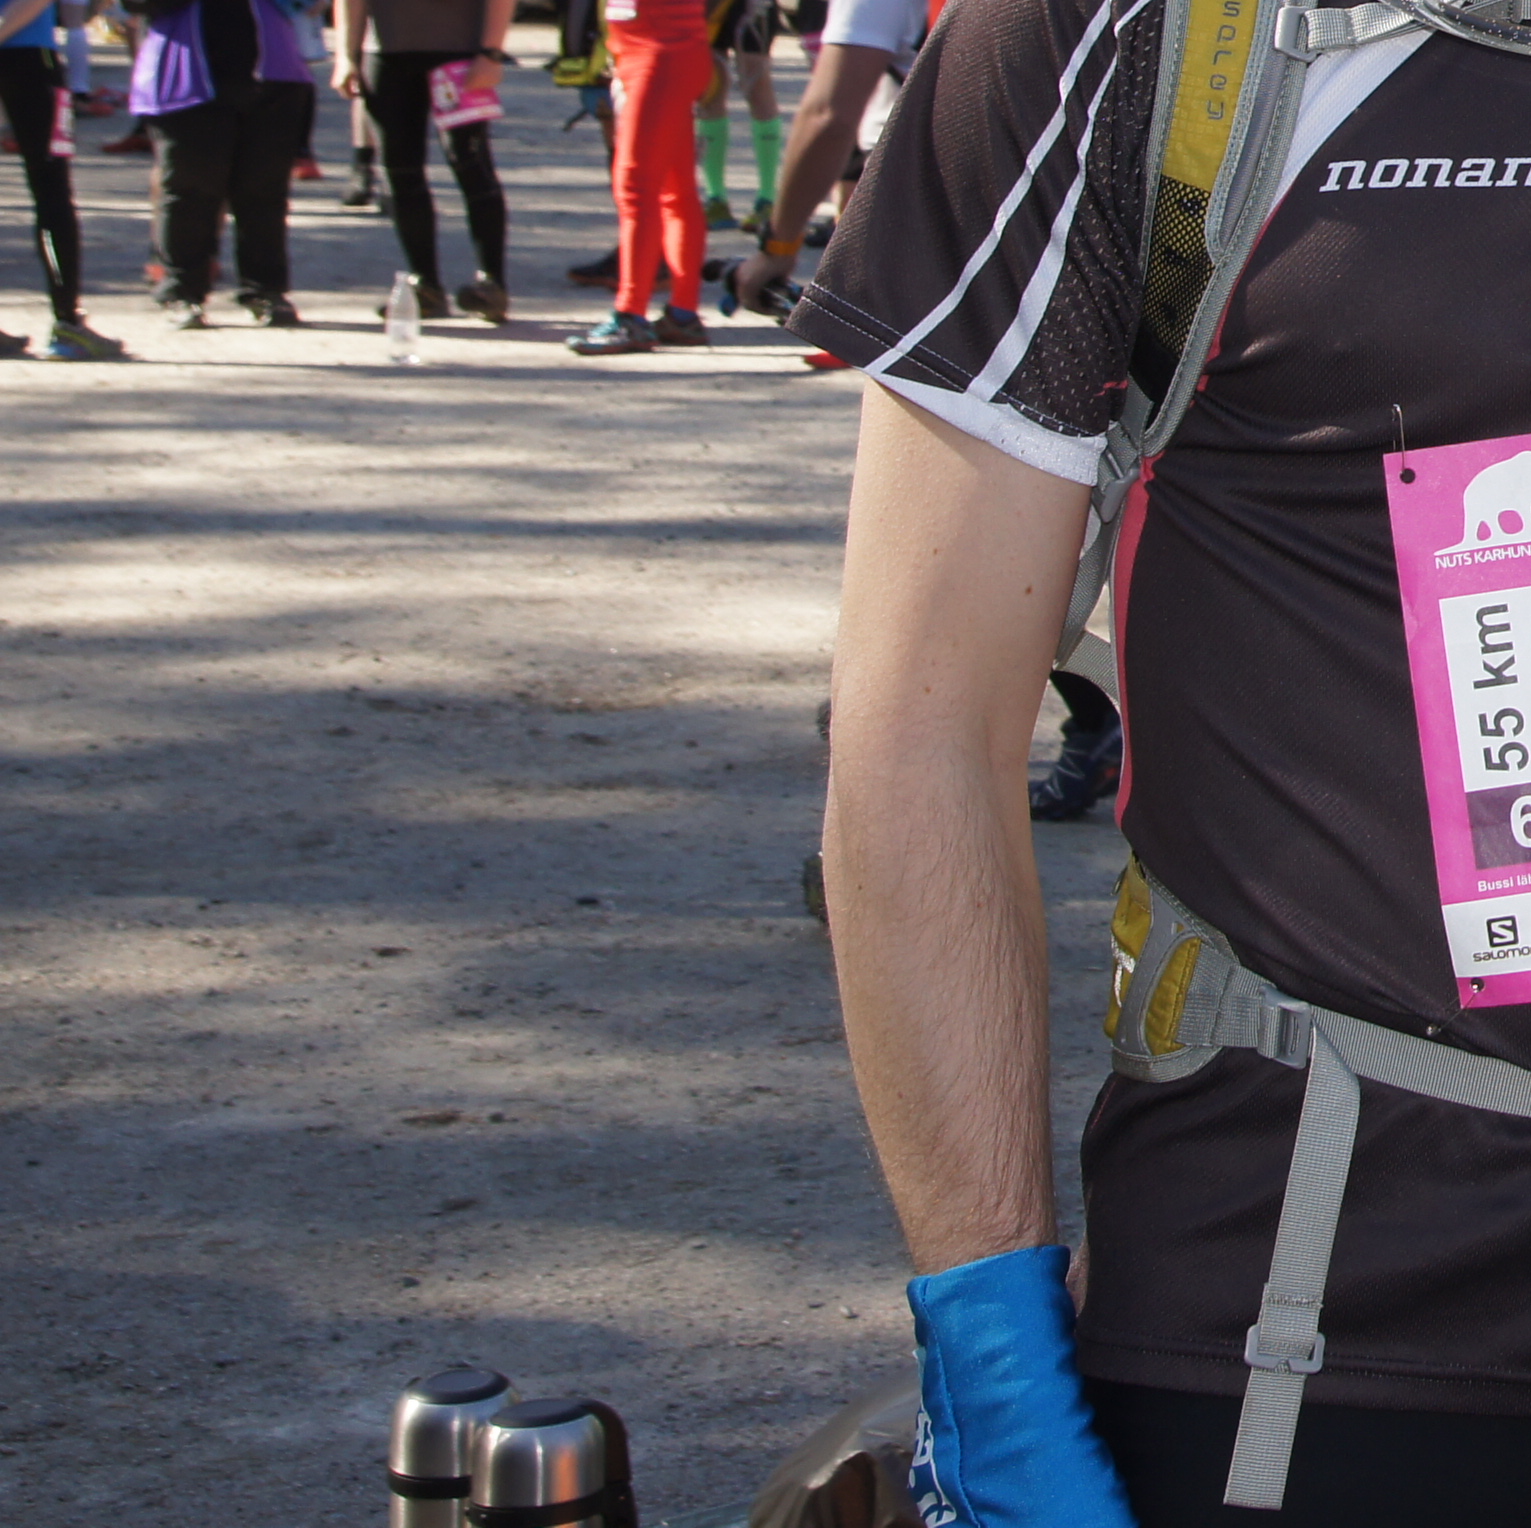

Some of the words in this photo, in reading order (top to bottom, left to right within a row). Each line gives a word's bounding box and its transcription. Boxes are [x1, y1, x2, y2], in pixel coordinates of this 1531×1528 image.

[1434, 551, 1473, 570] NUTS
[1472, 603, 1519, 690] km
[1477, 707, 1530, 772] 55
[1477, 879, 1515, 893] Bussi
